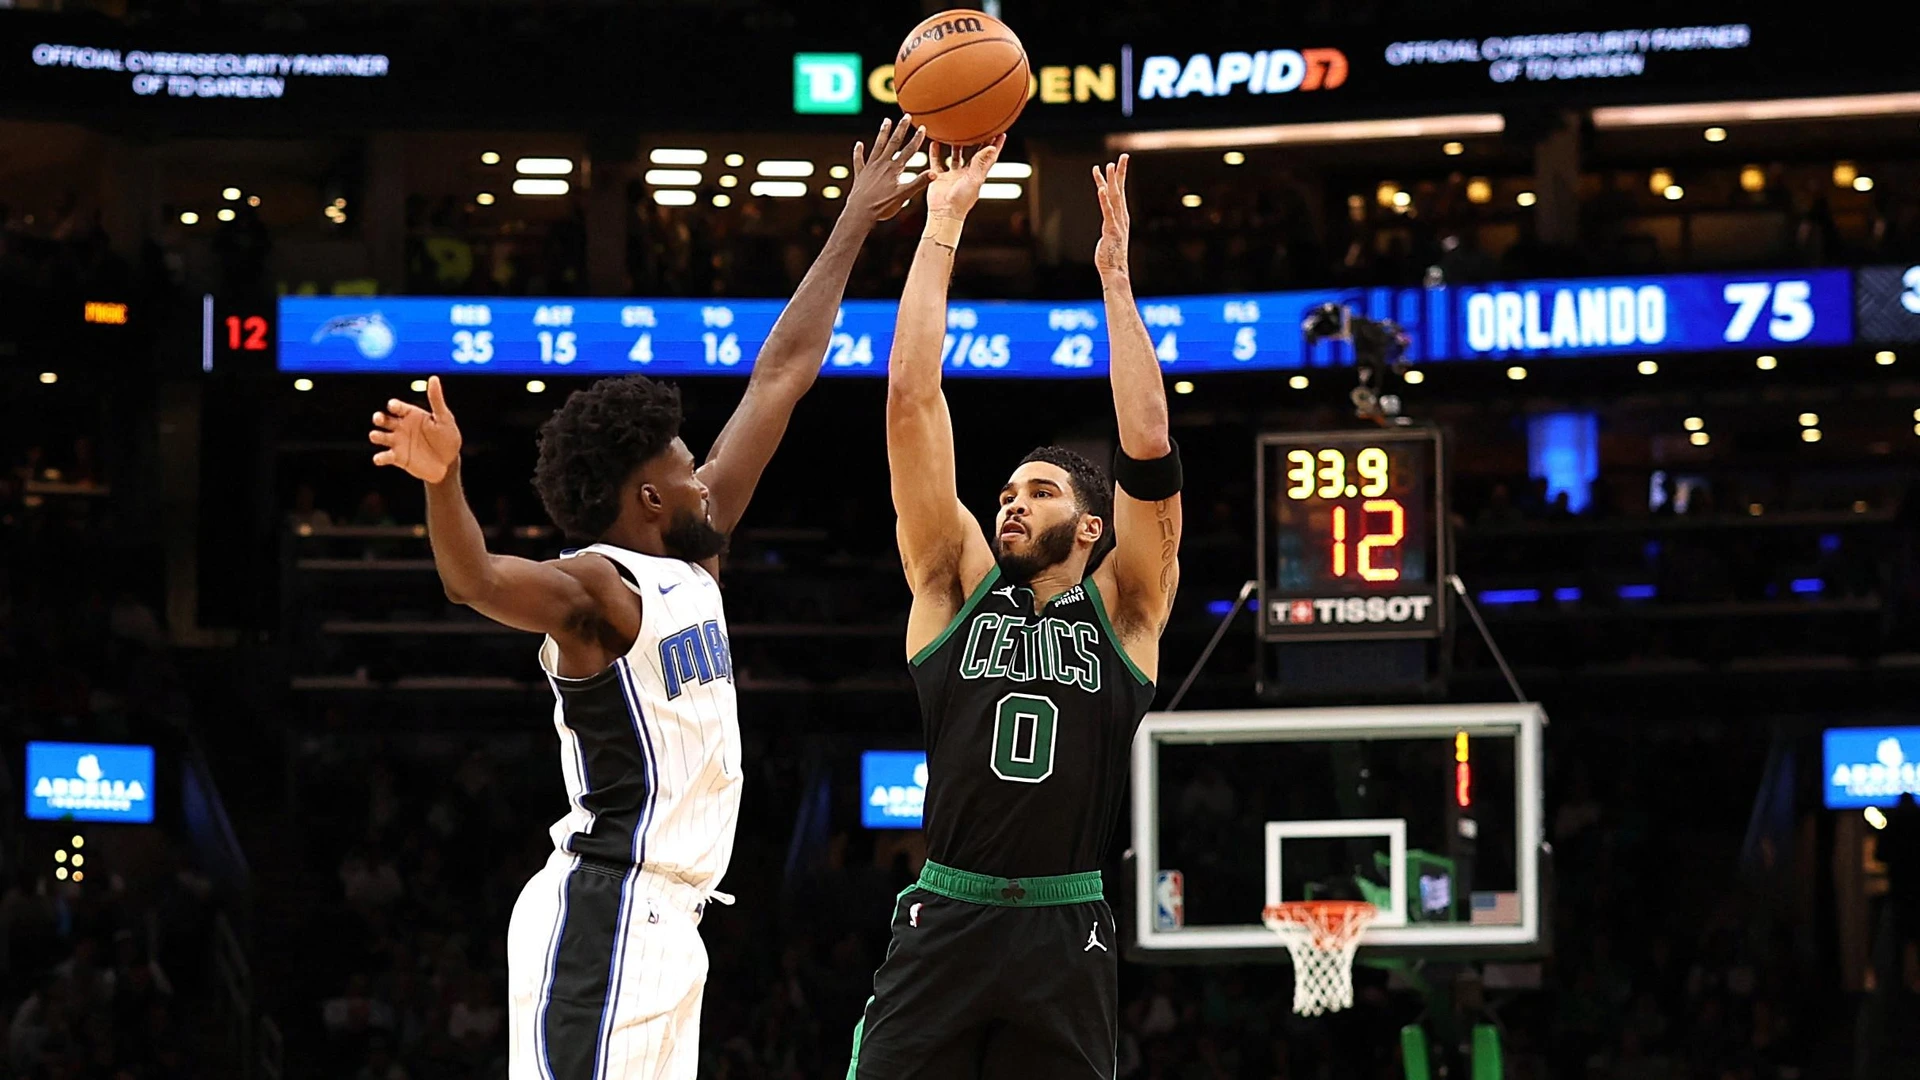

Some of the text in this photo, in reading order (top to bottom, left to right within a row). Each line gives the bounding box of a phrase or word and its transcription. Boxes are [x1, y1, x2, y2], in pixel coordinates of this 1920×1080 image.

[900, 17, 984, 63] Wilson
[799, 62, 857, 103] TD
[226, 315, 268, 350] 12
[1468, 281, 1815, 351] ORLANDO 75
[452, 331, 494, 364] 35
[538, 331, 577, 364] 15
[629, 332, 654, 364] 4
[703, 333, 741, 366] 16
[1052, 334, 1094, 367] 42
[1156, 331, 1179, 363] 4
[1232, 327, 1257, 361] 5
[1287, 448, 1389, 500] 33.9
[1332, 499, 1405, 582] 12
[1054, 591, 1086, 608] PRINT
[1312, 595, 1433, 623] TISSOT
[990, 692, 1059, 783] 0
